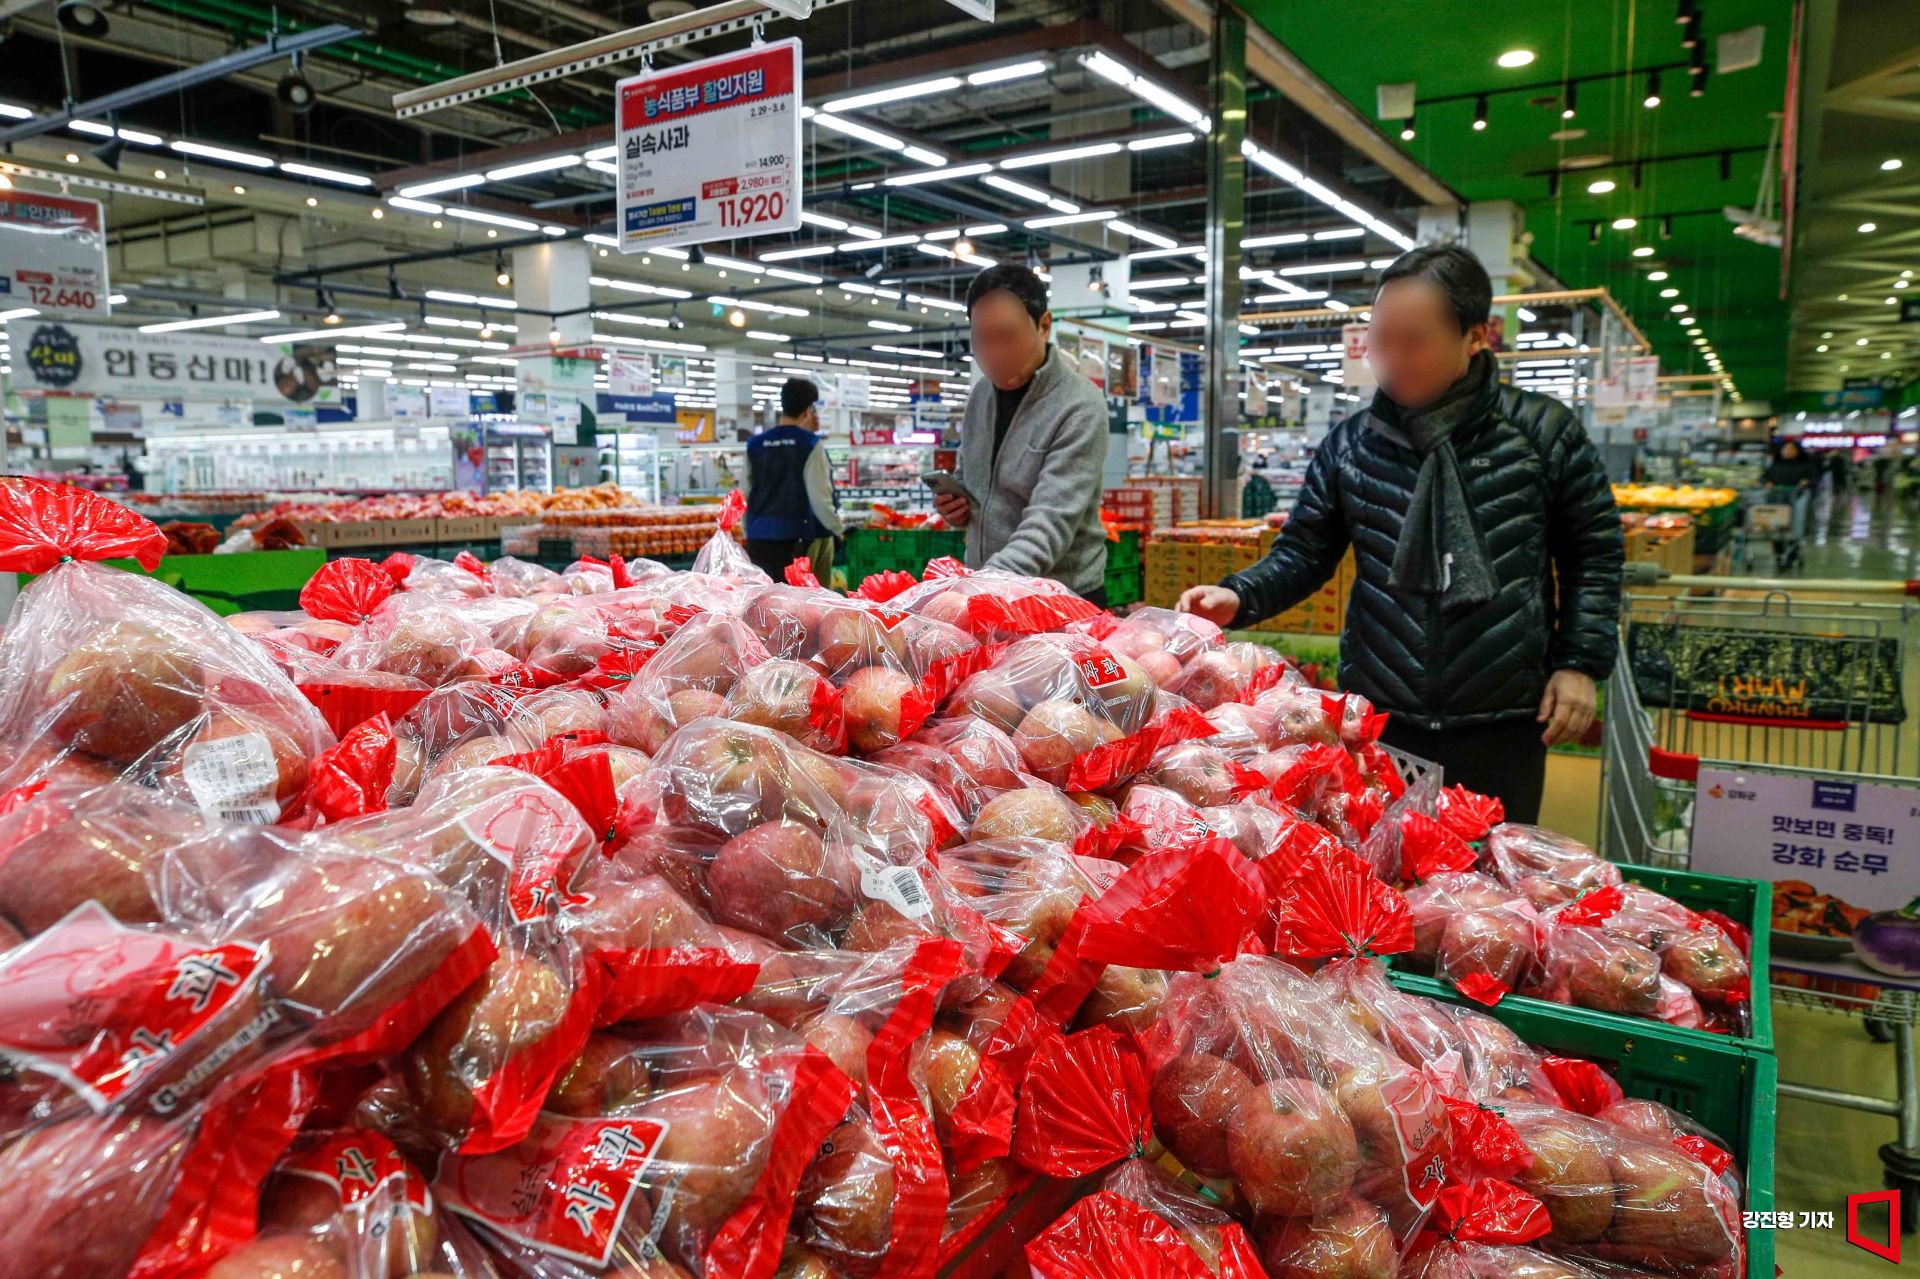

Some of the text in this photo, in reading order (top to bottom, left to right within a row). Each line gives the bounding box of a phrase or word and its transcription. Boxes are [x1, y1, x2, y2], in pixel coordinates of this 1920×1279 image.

[643, 68, 765, 117] 농식품부 할인지원
[625, 125, 690, 160] 실속사과
[718, 191, 784, 228] 11,920
[28, 285, 96, 309] 12,640
[1083, 658, 1120, 684] 사과
[1772, 815, 1895, 846] 맛보면 중독!
[1772, 843, 1889, 876] 강화 순무
[564, 1124, 644, 1237] 사과
